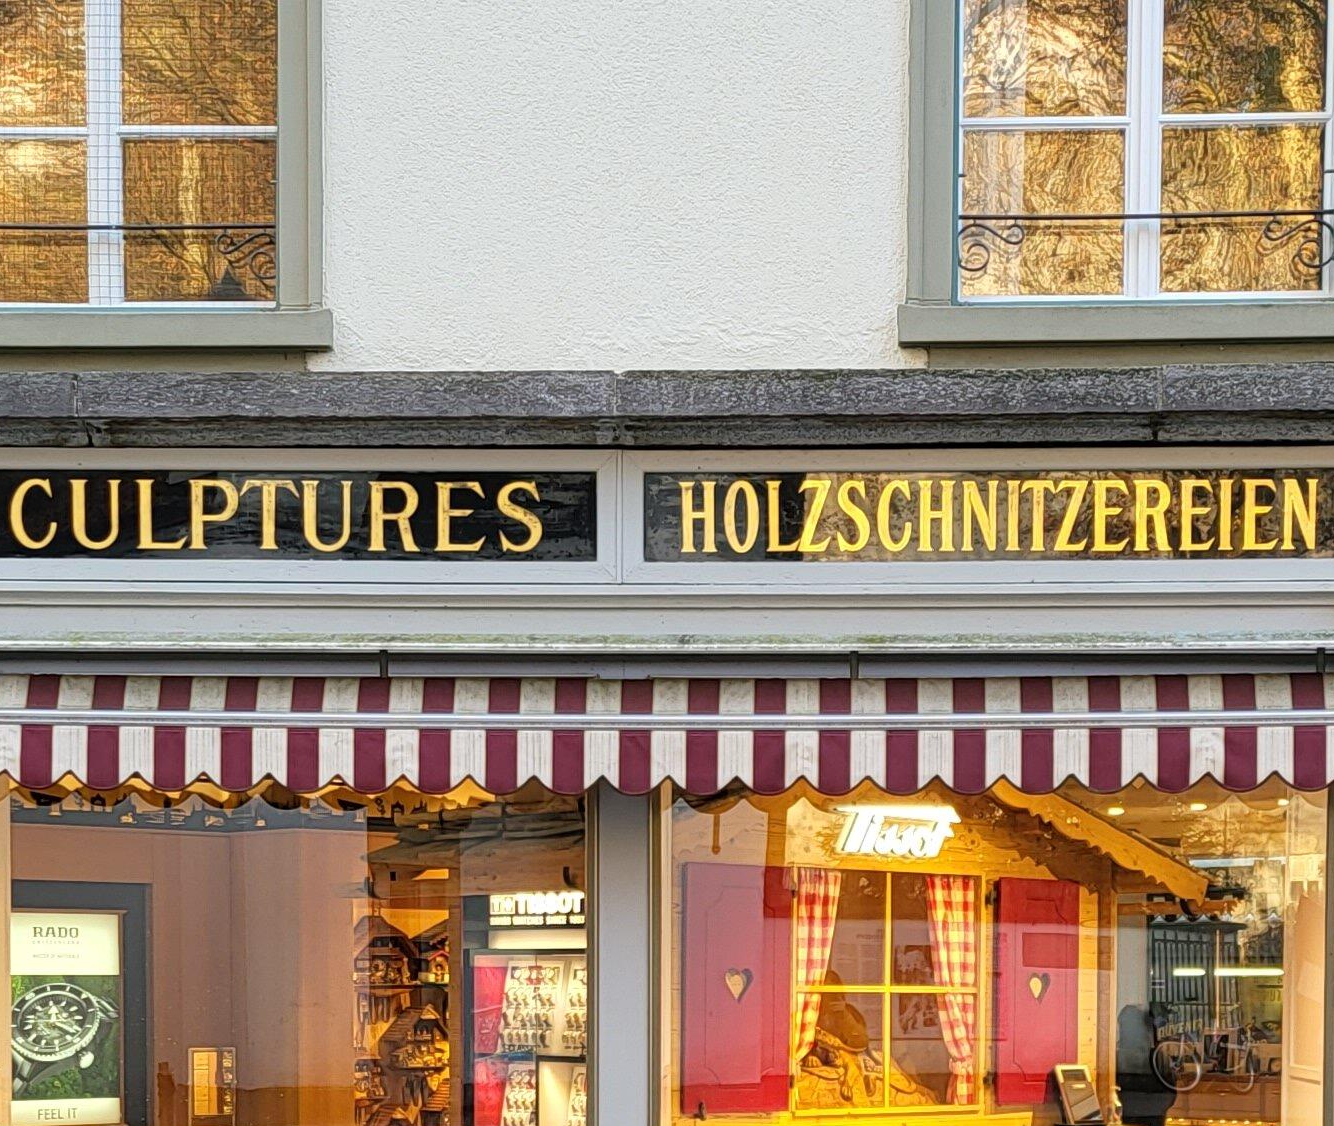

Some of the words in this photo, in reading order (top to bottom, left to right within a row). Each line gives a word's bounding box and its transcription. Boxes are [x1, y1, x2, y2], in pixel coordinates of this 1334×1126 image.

[678, 477, 1319, 554] HOLZSCHNITZEREIEN
[32, 926, 79, 938] RADO
[38, 1108, 64, 1120] FEEL
[67, 1108, 77, 1119] IT
